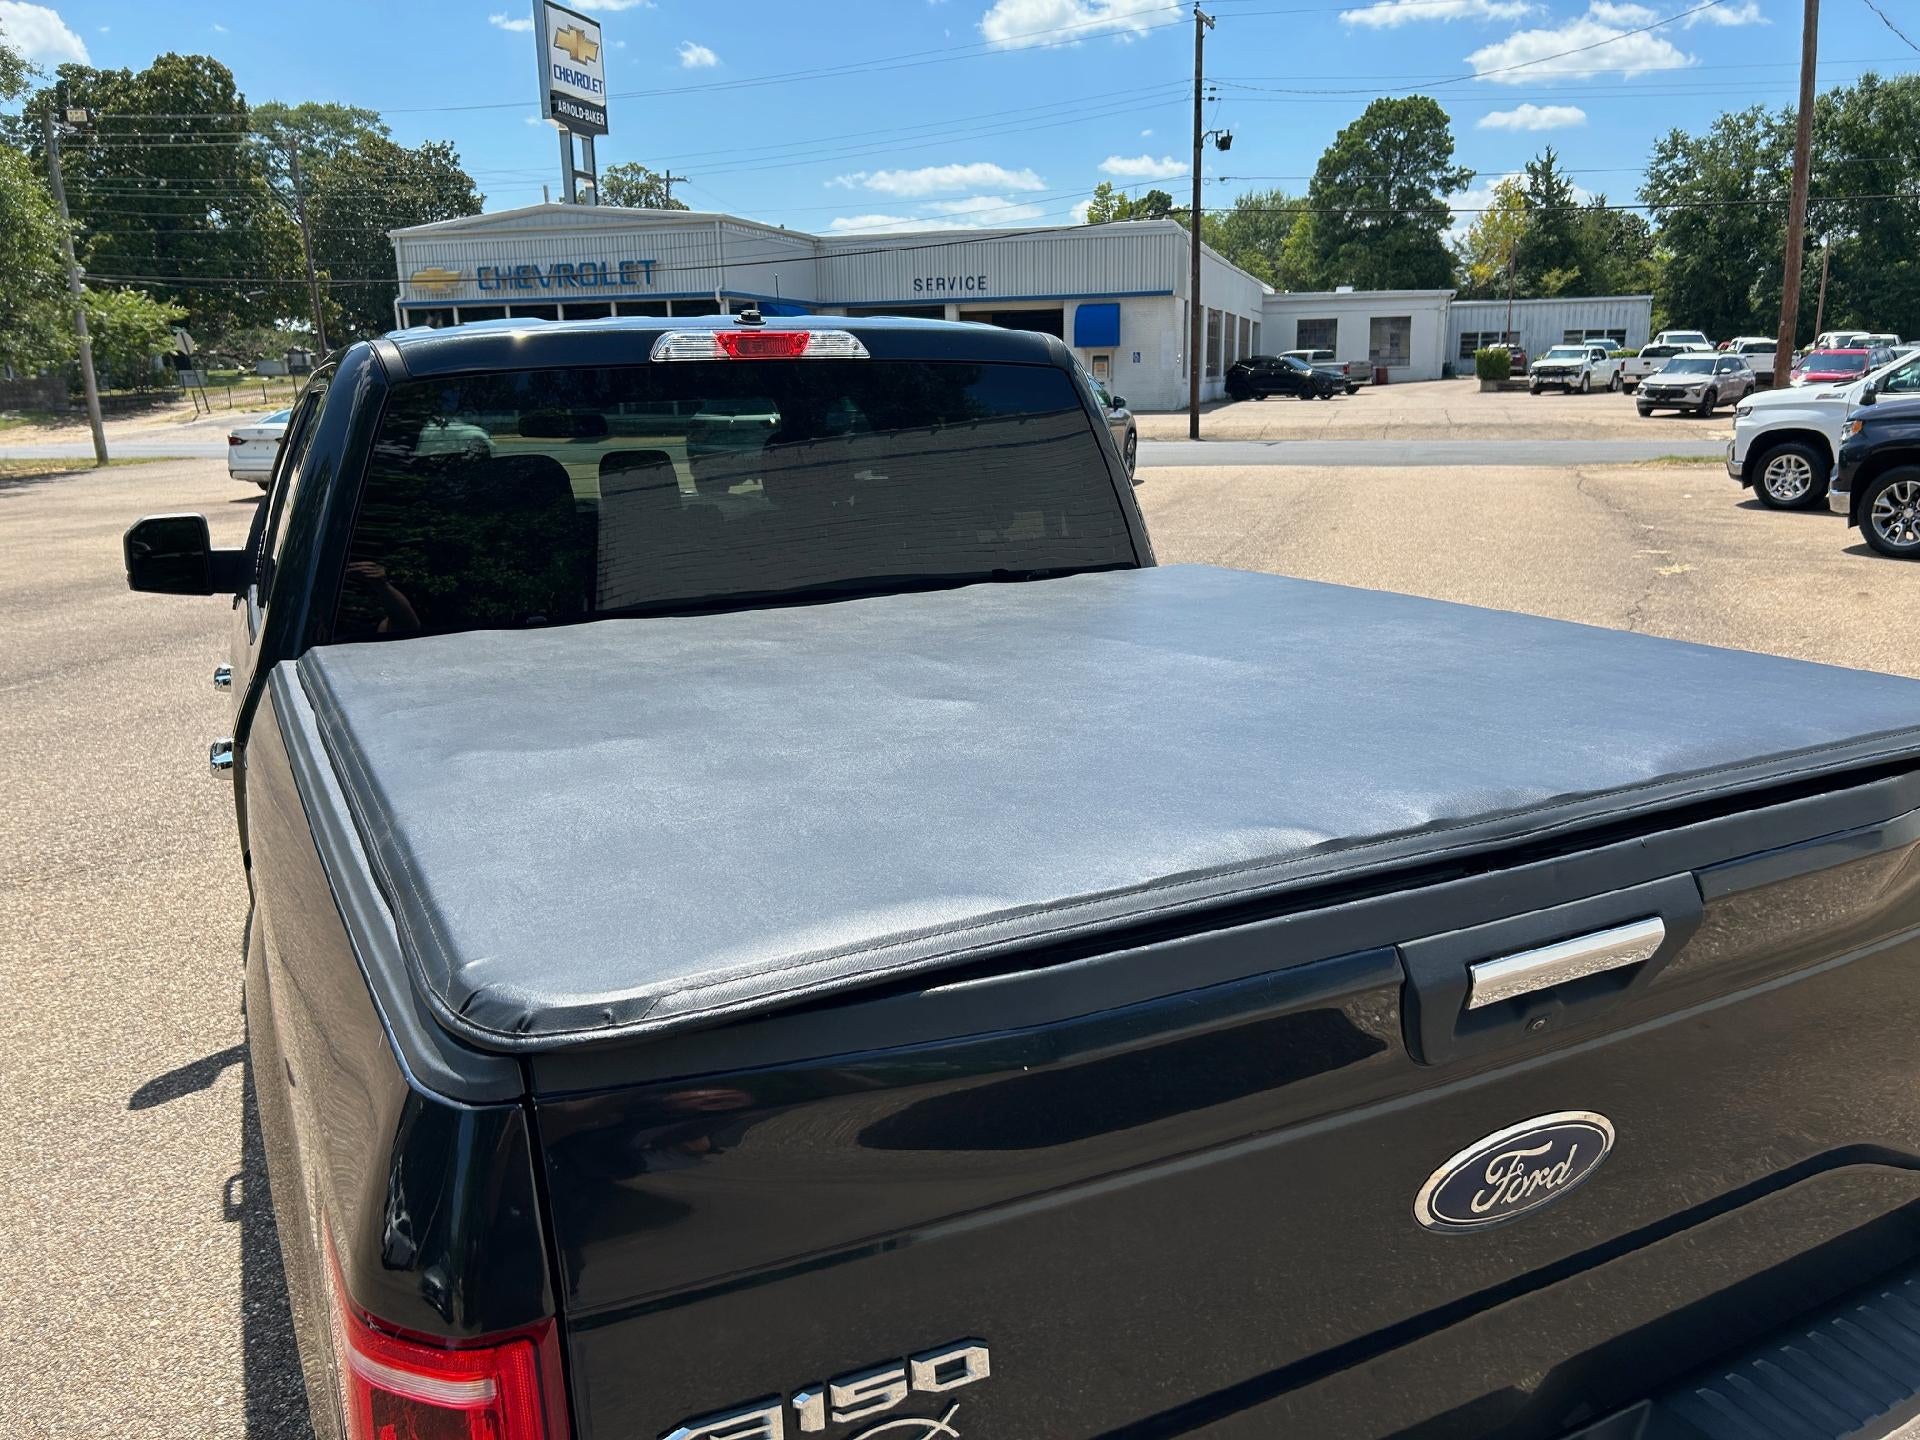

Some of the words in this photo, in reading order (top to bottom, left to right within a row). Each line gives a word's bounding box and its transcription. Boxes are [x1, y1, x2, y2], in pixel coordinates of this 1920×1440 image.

[553, 63, 604, 95] CHEVROLET
[557, 99, 605, 126] ARNOLD-BAKER
[476, 258, 657, 292] CHEVROLET
[912, 274, 988, 292] SERVICE
[1469, 1140, 1578, 1213] Ford
